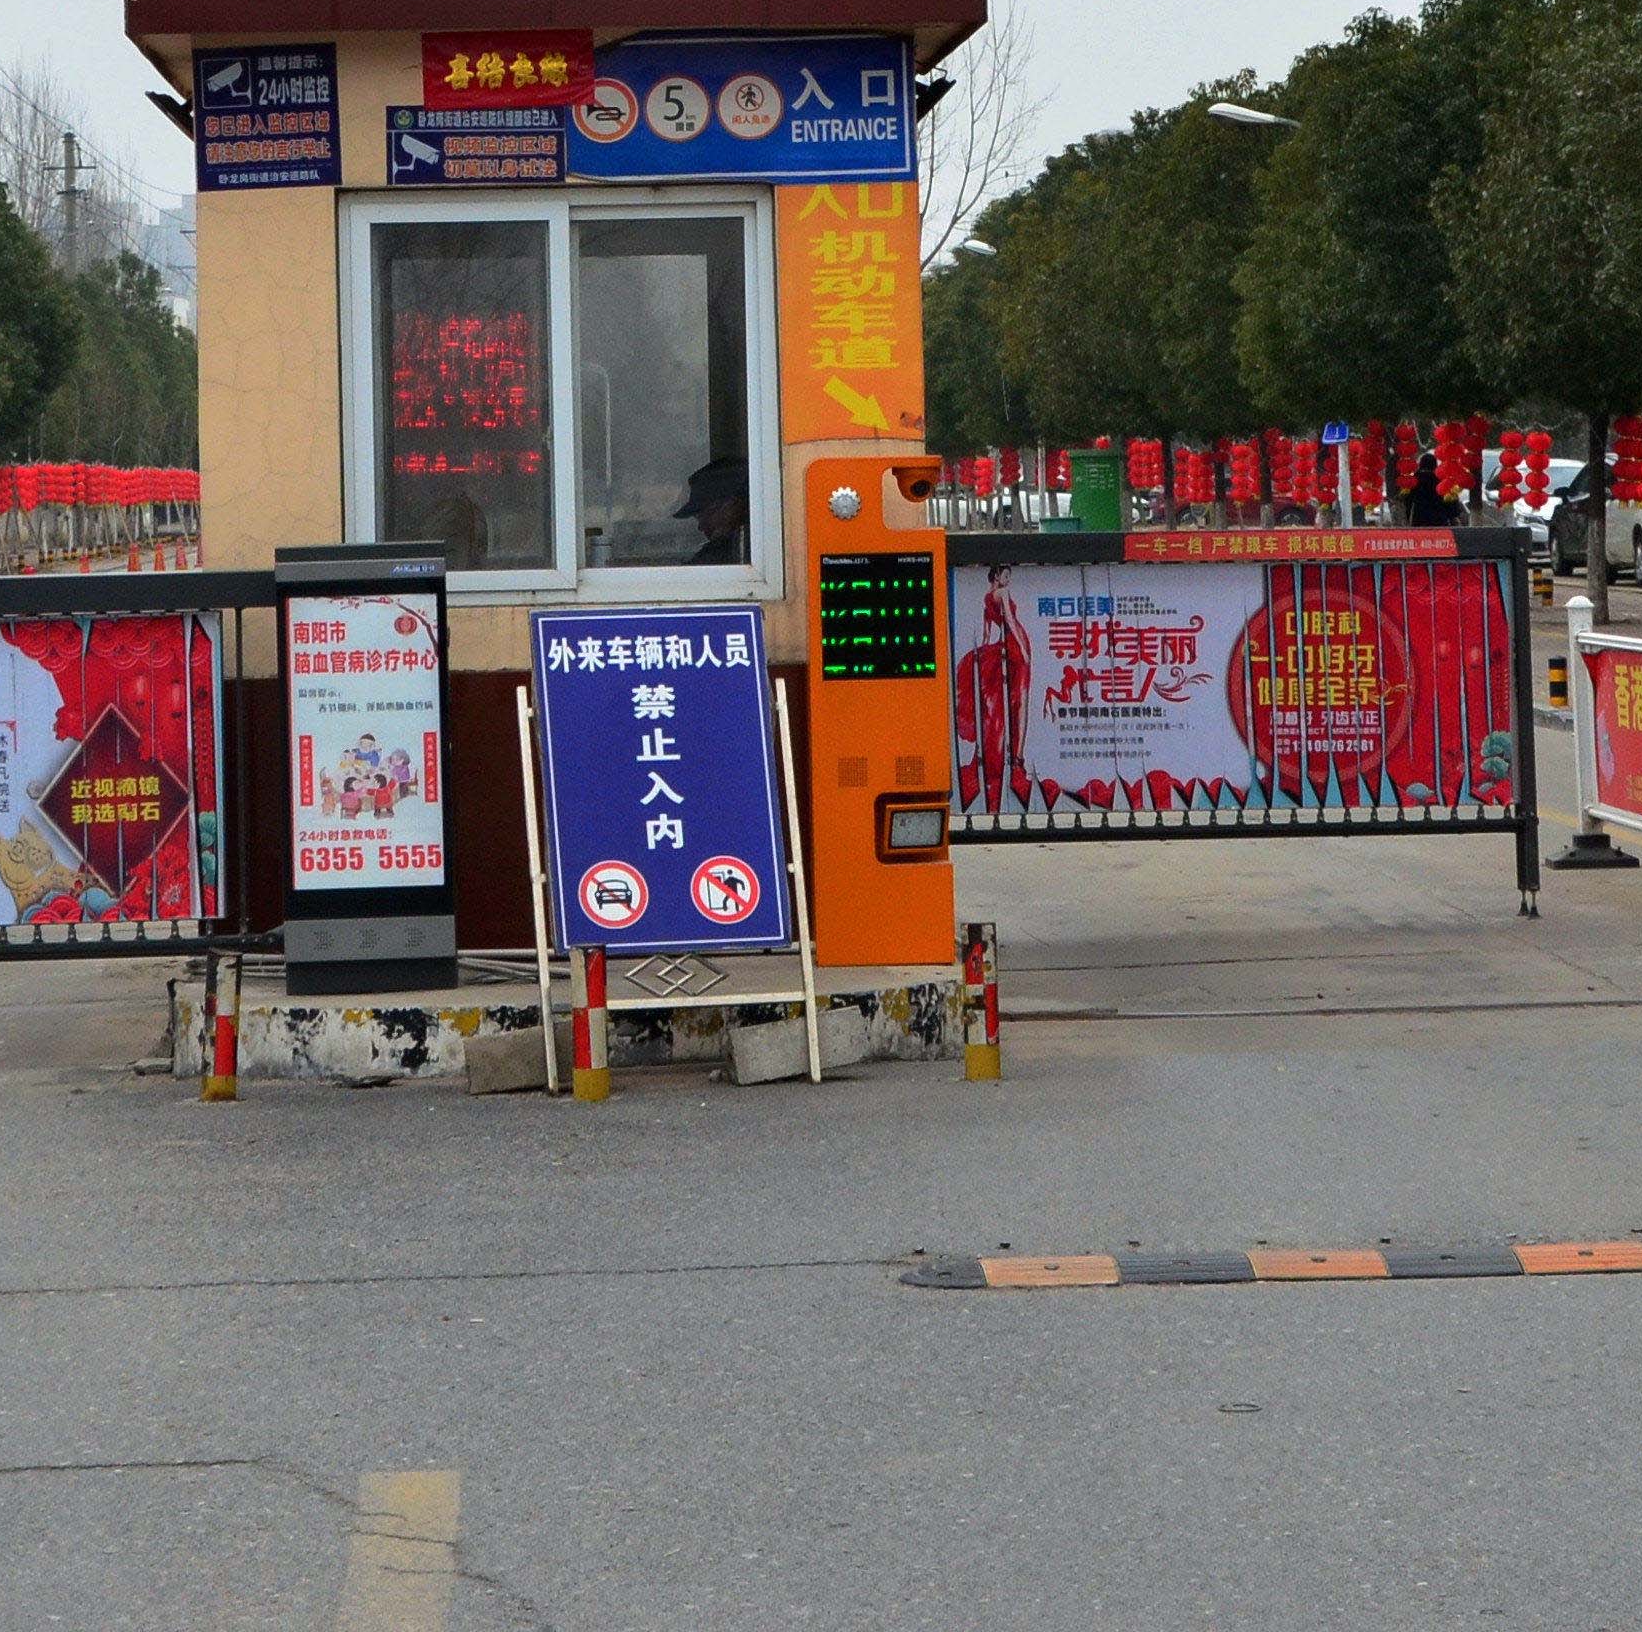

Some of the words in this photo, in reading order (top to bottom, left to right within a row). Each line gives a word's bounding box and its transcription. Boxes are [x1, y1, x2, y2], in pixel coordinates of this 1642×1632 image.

[258, 75, 330, 106] 24小时监控
[663, 85, 685, 121] 5
[791, 67, 896, 112] 入口
[791, 116, 898, 144] ENTRANCE
[807, 230, 901, 370] 机动车道
[1135, 535, 1204, 556] 一车一档
[1211, 534, 1280, 554] 严禁跟车
[1288, 533, 1356, 554] 损坏赔偿
[1037, 596, 1114, 618] 南石医美
[293, 620, 346, 644] 南阳市
[1047, 614, 1205, 666] 寻找美丽
[293, 649, 438, 675] 脑血管病诊疗中心
[547, 633, 752, 674] 外来车辆和人员
[631, 684, 685, 850] 禁止入内
[70, 776, 161, 799] 近视摘镜
[71, 802, 161, 824] 我选南石
[300, 847, 365, 872] 6355
[378, 844, 442, 869] 5555
